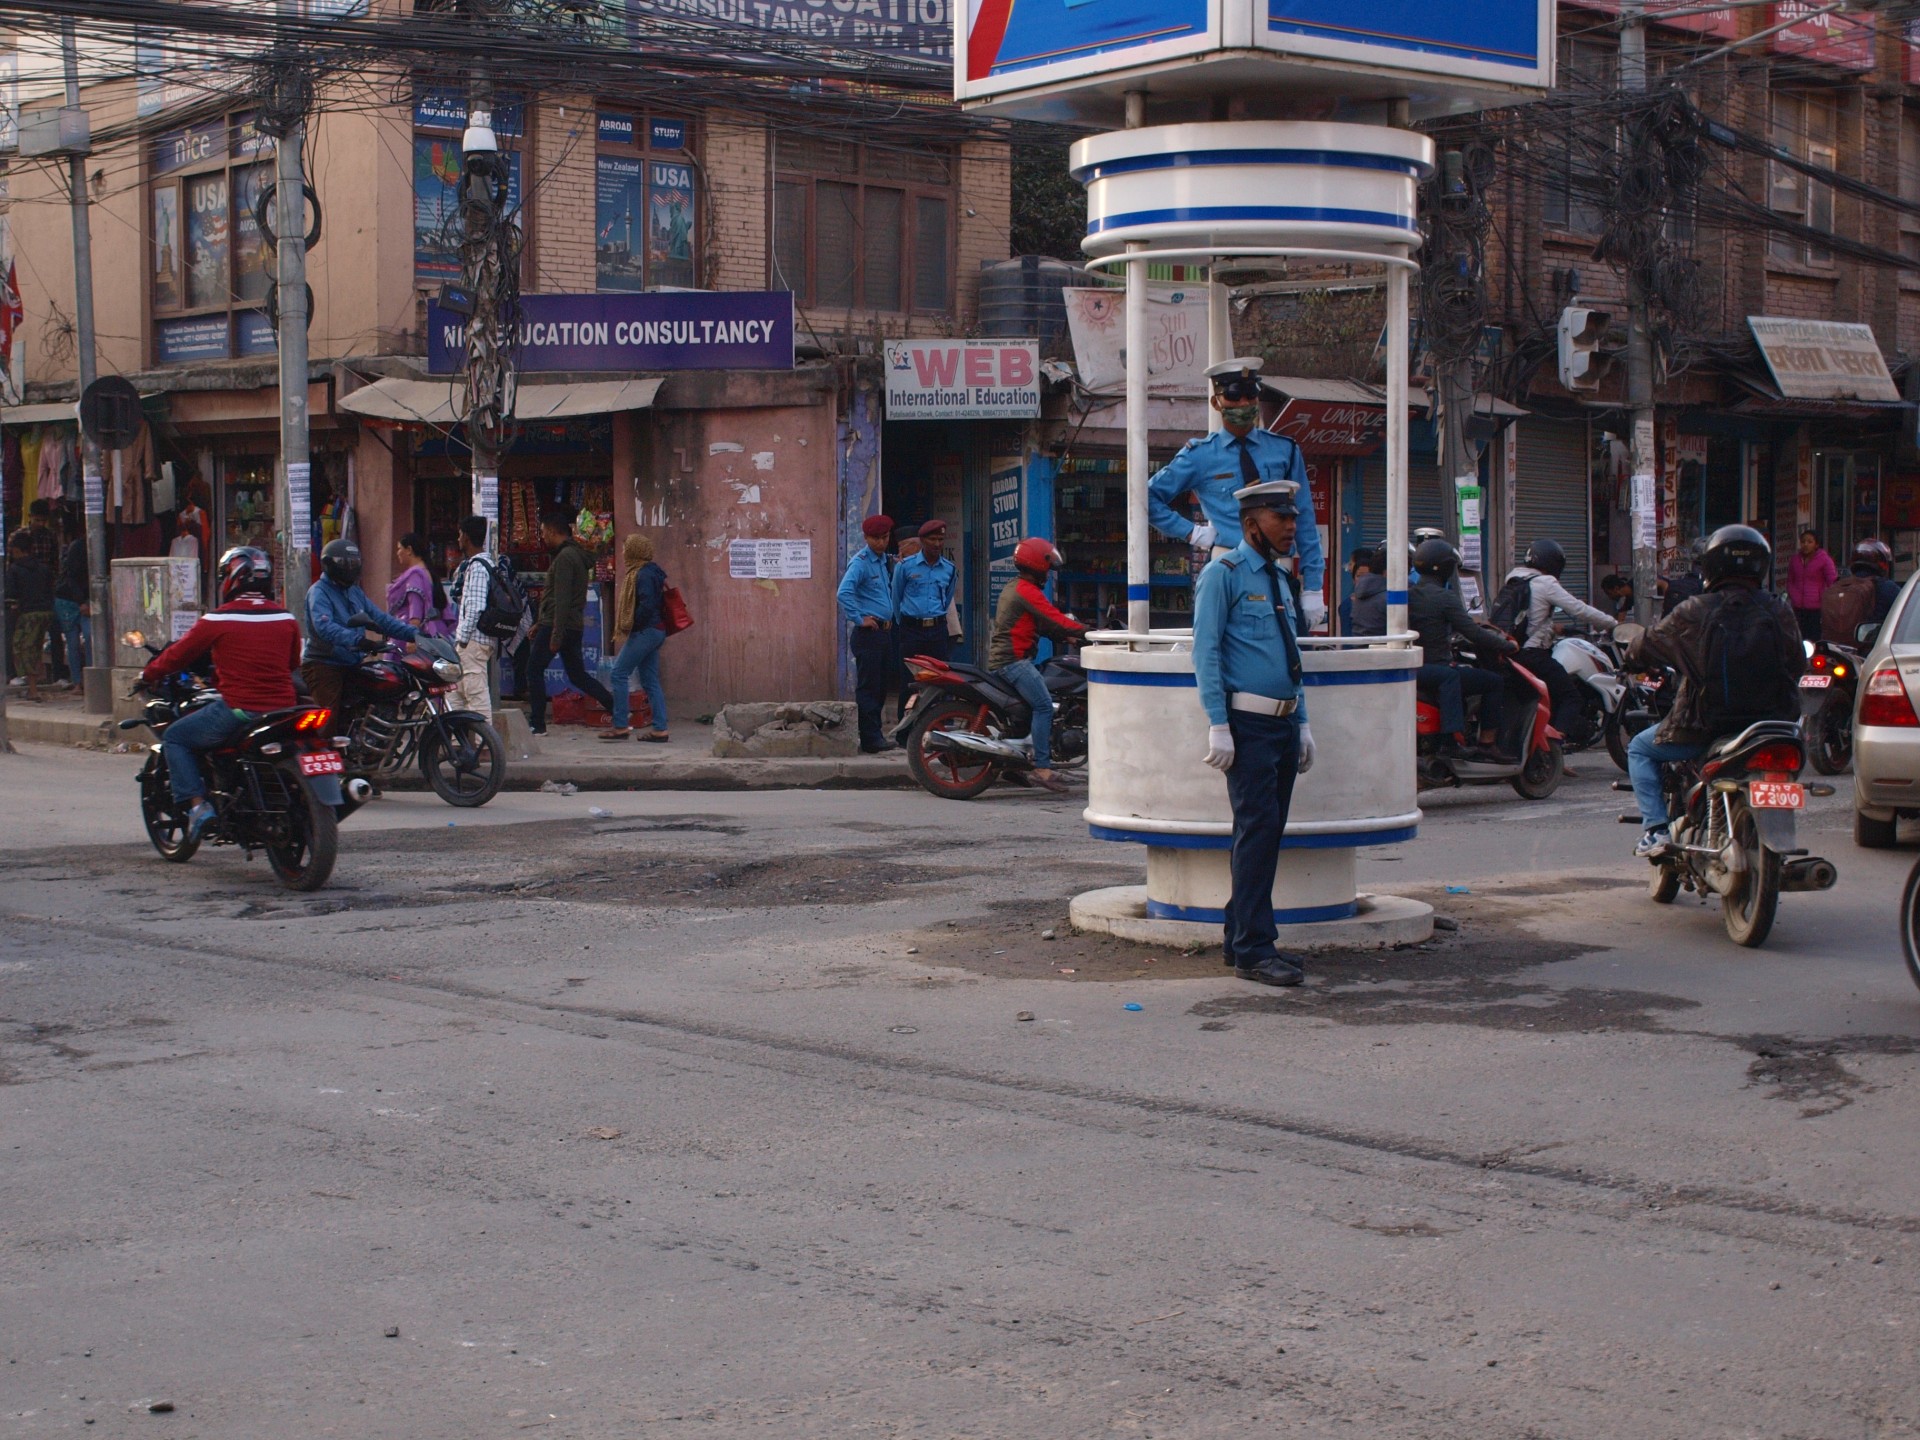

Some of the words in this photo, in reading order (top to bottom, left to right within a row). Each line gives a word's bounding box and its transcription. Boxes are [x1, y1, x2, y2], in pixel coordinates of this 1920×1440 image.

[599, 119, 632, 133] ABROAD
[654, 126, 680, 140] STUDY
[175, 131, 211, 163] nice
[598, 160, 614, 171] New
[614, 161, 639, 173] Zealand
[656, 166, 690, 188] USA
[195, 181, 228, 213] USA
[496, 323, 609, 349] EUCATION
[616, 320, 775, 346] CONSULTANCY
[912, 348, 1034, 388] WEB
[890, 389, 970, 406] International
[975, 387, 1037, 405] Education
[1321, 407, 1387, 427] UNIQUE
[1301, 427, 1373, 445] MOBILE
[991, 476, 1018, 494] ABROAD
[993, 492, 1019, 514] STUDY
[991, 517, 1019, 541] TEST
